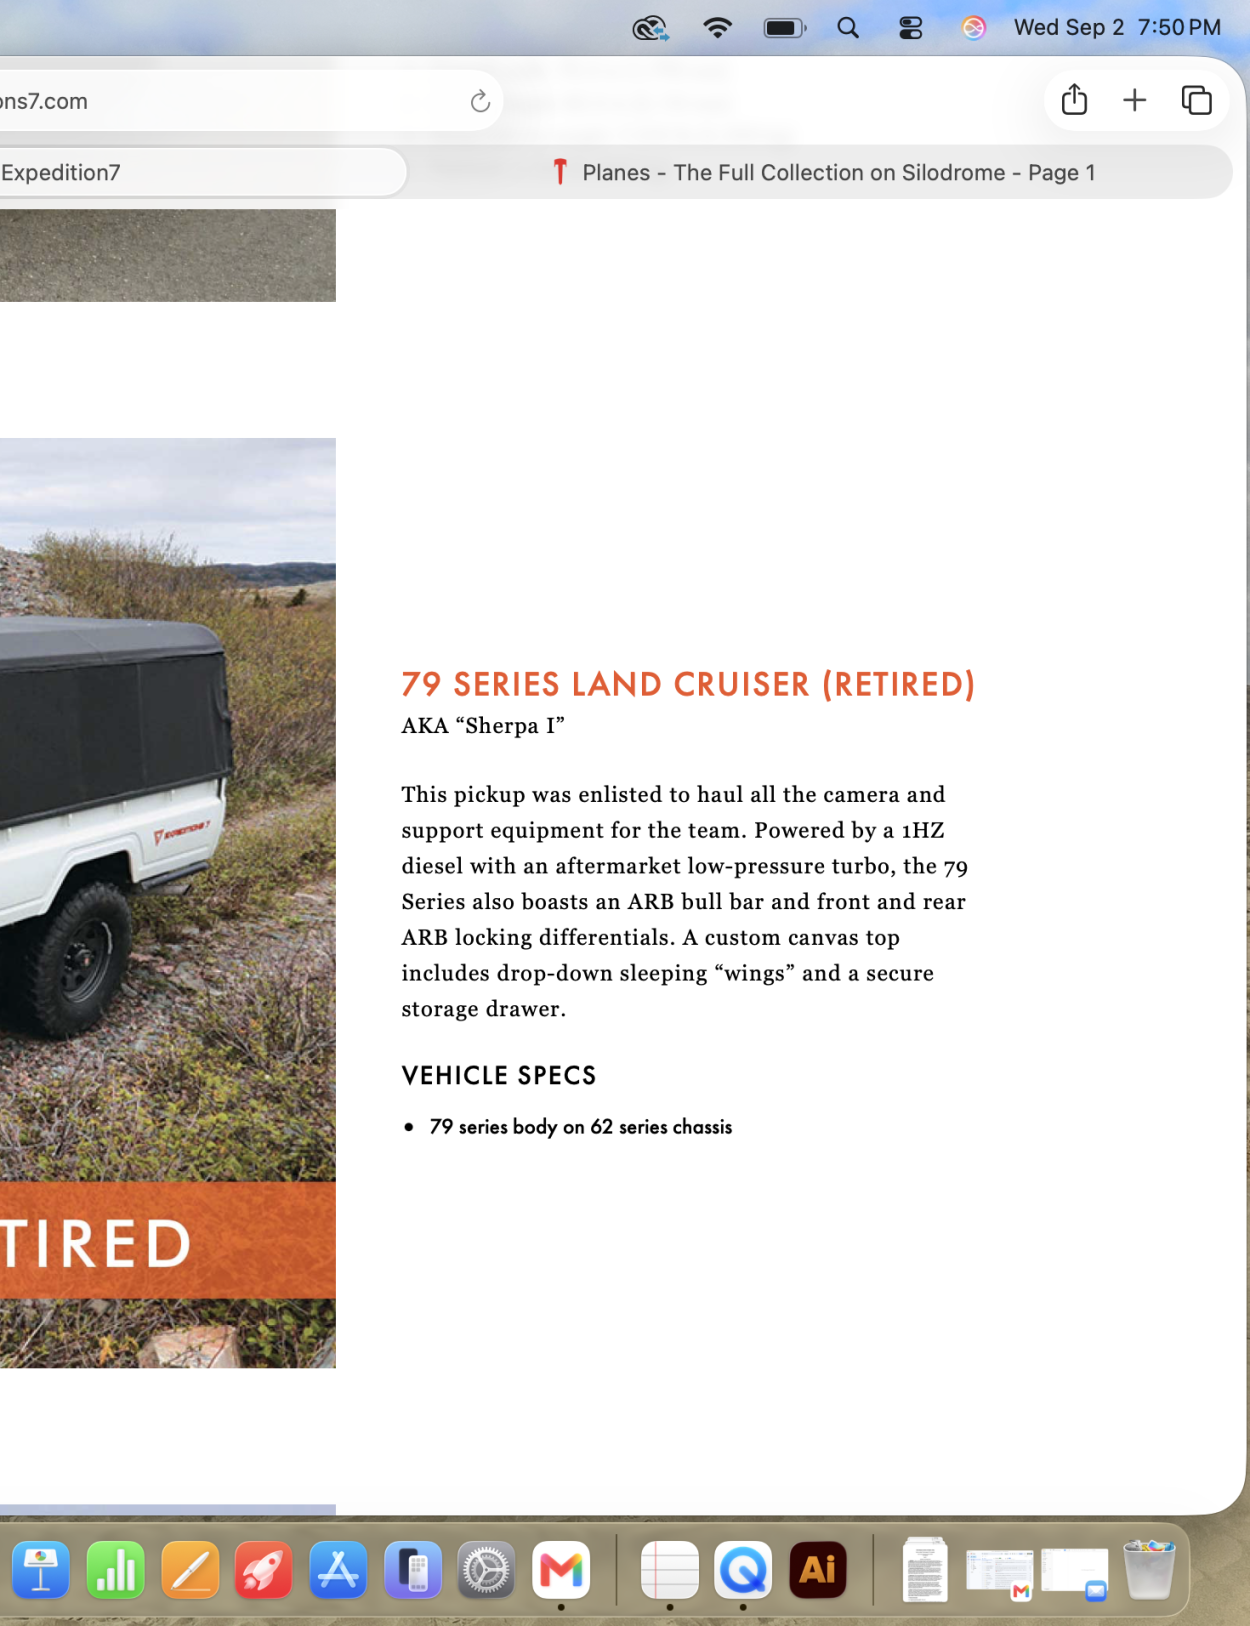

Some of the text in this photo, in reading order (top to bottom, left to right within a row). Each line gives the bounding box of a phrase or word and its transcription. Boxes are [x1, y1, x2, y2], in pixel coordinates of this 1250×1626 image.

[1014, 17, 1221, 40] Wed Sep 2 7:50 PM
[1, 162, 121, 185] Expedition7
[583, 163, 651, 182] Planes
[673, 163, 713, 182] The
[719, 163, 754, 182] Full
[761, 162, 864, 182] Collection
[870, 167, 896, 182] on
[902, 162, 1006, 182] Silodrome
[1029, 163, 1079, 186] Page
[1086, 163, 1094, 181] 1
[402, 668, 974, 703] 79 SERIES LAND CRUISER (RETIRED)
[400, 715, 565, 739] AKA “Sherpa I”
[400, 784, 946, 808] This pickup was enlisted to haul all the camera and
[401, 820, 945, 844] support equipment for the team. Powered by a 1HZ
[401, 855, 968, 880] diesel with an aftermarket low-pressure turbo, the 79
[401, 891, 967, 911] Series also boasts an ARB bull bar and front and rear
[400, 927, 900, 951] ARB locking differentials. A custom canvas top
[401, 962, 934, 987] includes drop-down sleeping “wings” and a secure
[401, 998, 566, 1022] storage drawer.
[401, 1064, 596, 1086] VEHICLE SPECS
[430, 1116, 733, 1140] 79 series body on 62 series chassis
[798, 1554, 835, 1583] Ai
